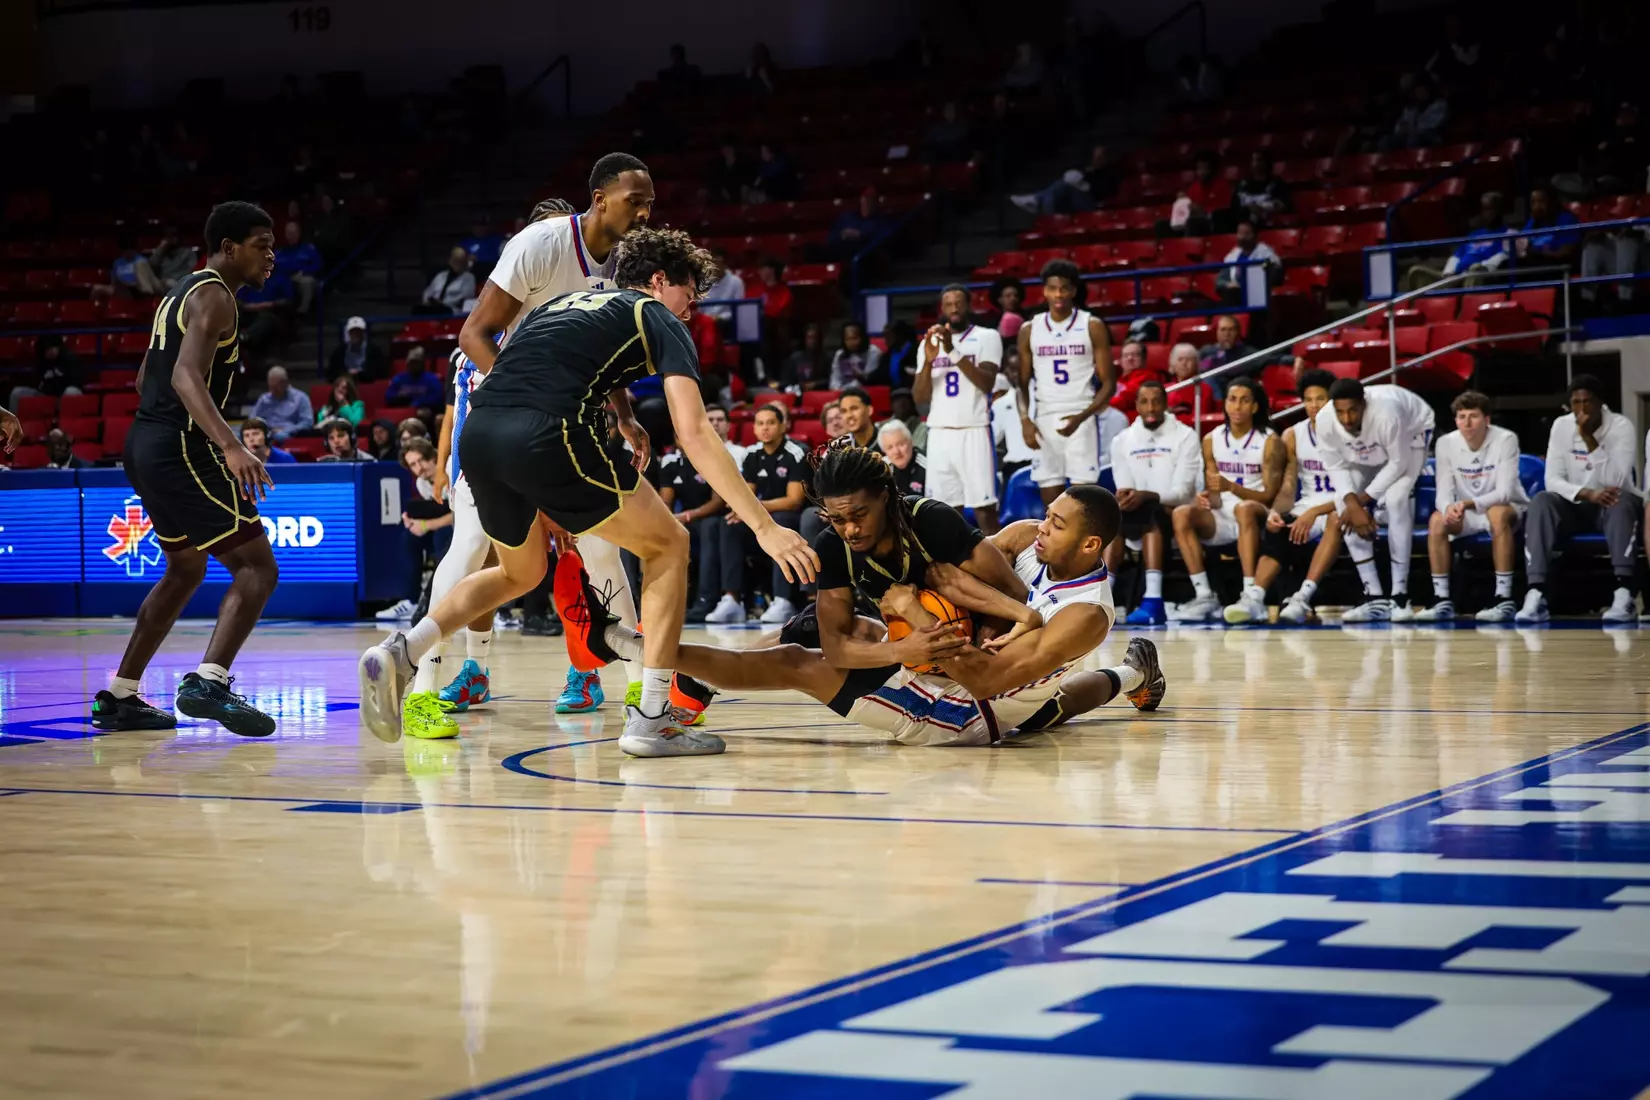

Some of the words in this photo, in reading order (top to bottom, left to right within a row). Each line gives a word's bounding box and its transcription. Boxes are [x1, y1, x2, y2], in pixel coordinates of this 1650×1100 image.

[286, 7, 331, 32] 119
[148, 296, 177, 351] 14
[945, 371, 960, 397] 8
[1053, 360, 1069, 385] 5
